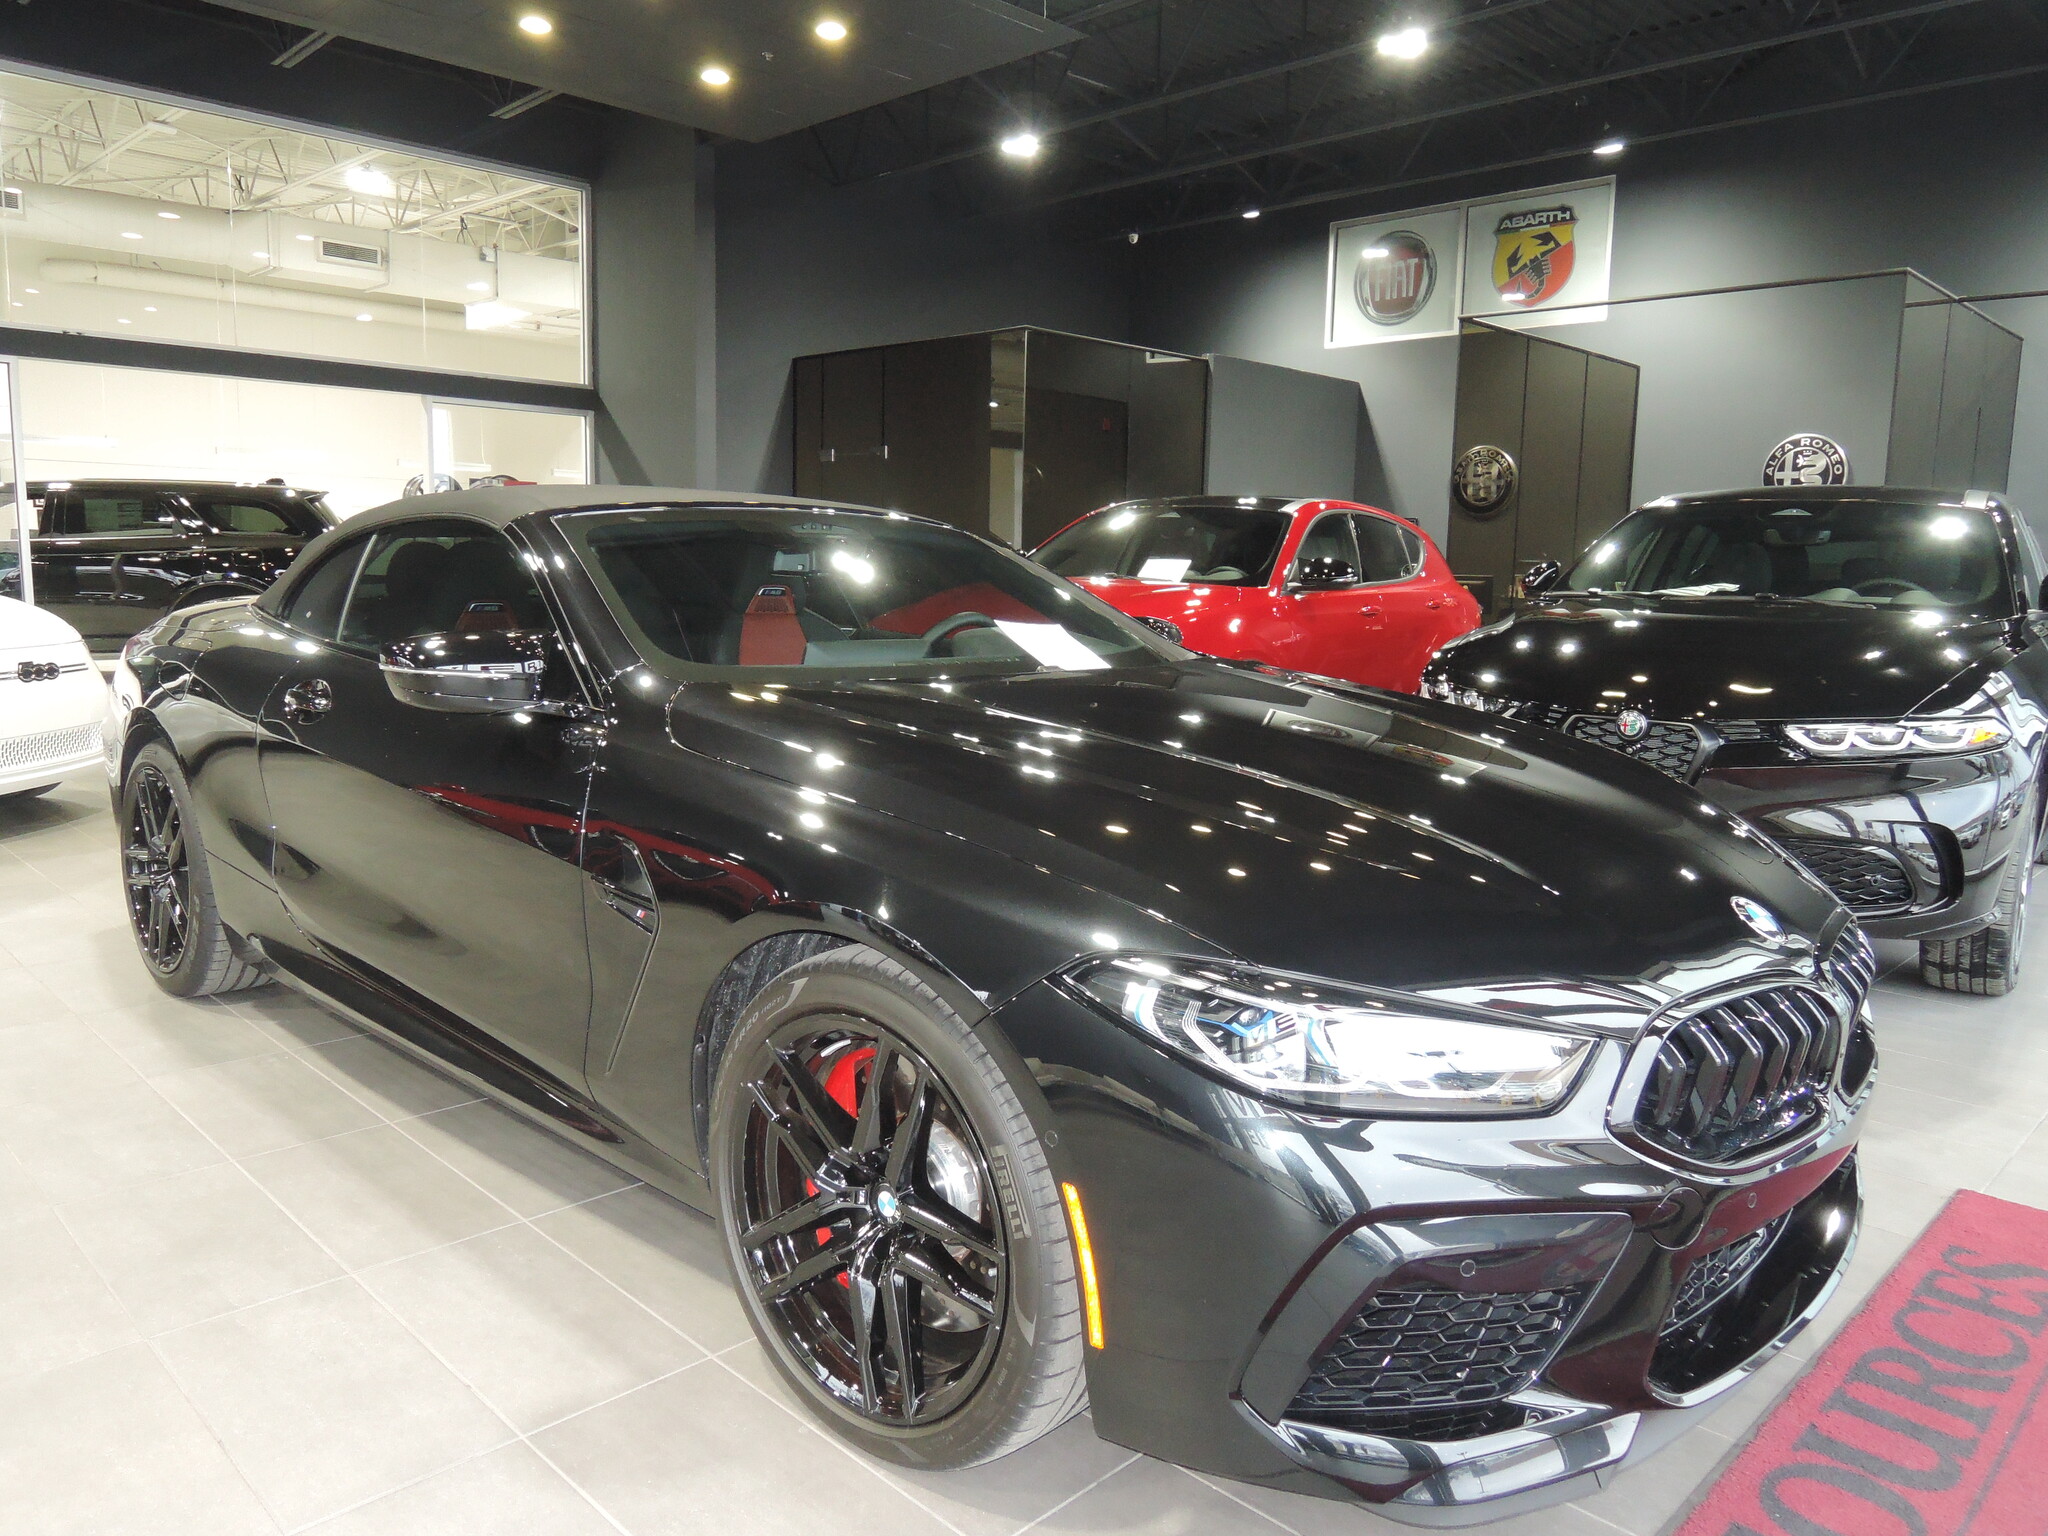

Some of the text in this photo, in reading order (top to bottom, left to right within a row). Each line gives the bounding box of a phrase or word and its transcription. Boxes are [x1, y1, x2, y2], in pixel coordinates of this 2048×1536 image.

[1500, 210, 1571, 229] ABARTH
[1374, 257, 1419, 302] FIAT
[1765, 437, 1843, 477] ALFA ROMEO
[18, 661, 60, 683] 500
[990, 1144, 1032, 1239] PIRELLI
[1722, 1244, 2048, 1536] OURCES
